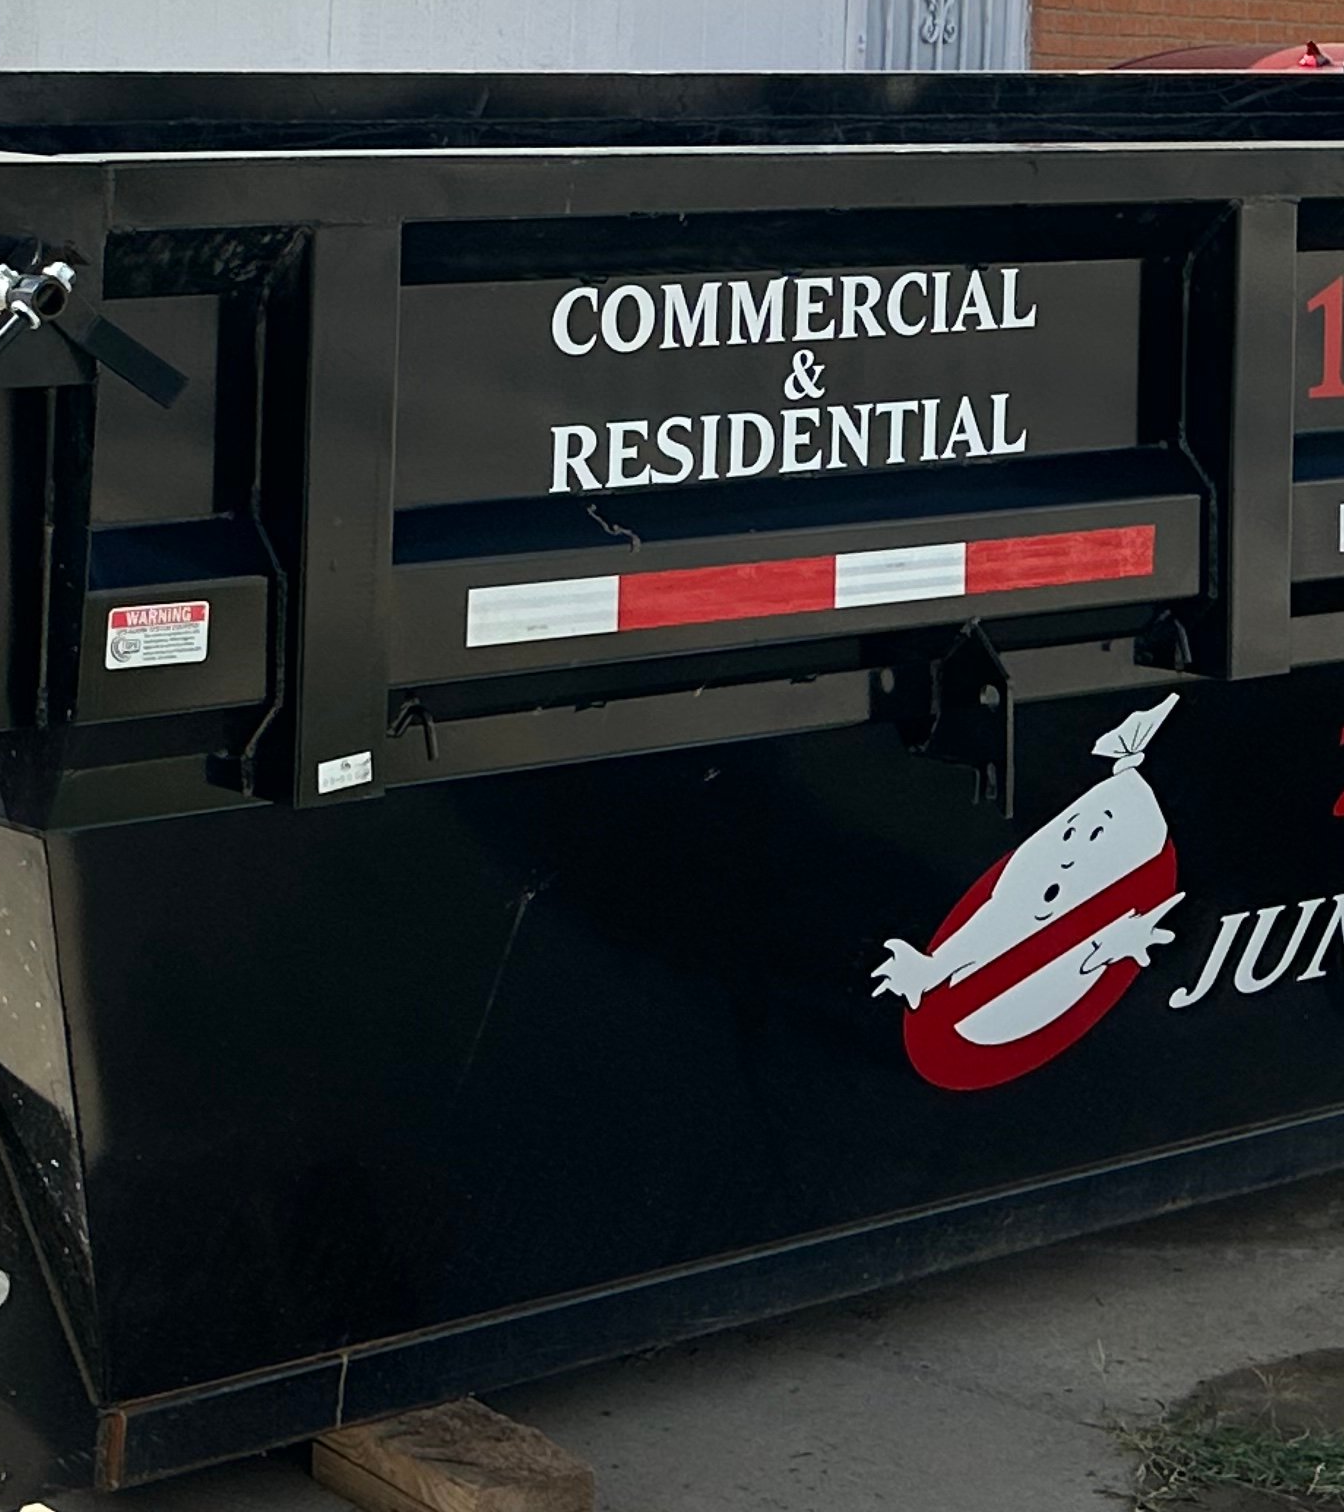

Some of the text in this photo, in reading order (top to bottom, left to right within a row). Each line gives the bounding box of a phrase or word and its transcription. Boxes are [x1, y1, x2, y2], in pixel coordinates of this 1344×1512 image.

[551, 268, 1037, 356] COMMERCIAL
[784, 349, 826, 401] &
[548, 393, 1027, 494] RESIDENTIAL
[127, 607, 192, 626] WARNING
